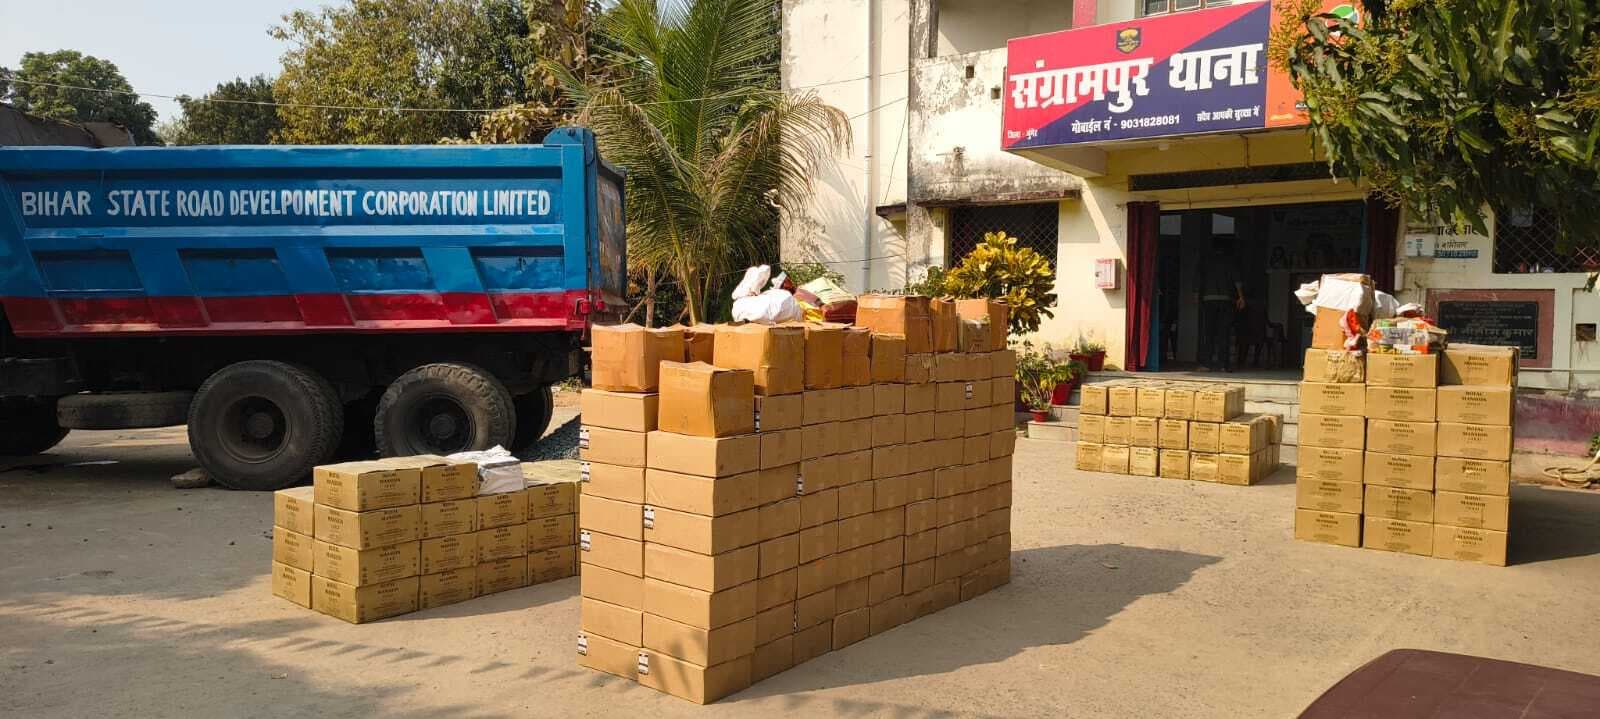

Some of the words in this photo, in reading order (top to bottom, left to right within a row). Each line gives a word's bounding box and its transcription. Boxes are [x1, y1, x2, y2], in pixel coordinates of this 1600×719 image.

[1009, 57, 1154, 113] संग्रामपुर
[1169, 43, 1264, 91] थाना
[1071, 118, 1102, 134] मोबाईल
[1120, 114, 1180, 129] 9031828081
[1212, 108, 1233, 121] आपकी
[21, 191, 92, 217] BIHAR
[107, 190, 170, 217] STATE
[176, 190, 224, 217] ROAD
[229, 190, 357, 217] DEVELPOMENT
[362, 190, 478, 217] CORPORATION
[484, 190, 551, 216] LIMITED
